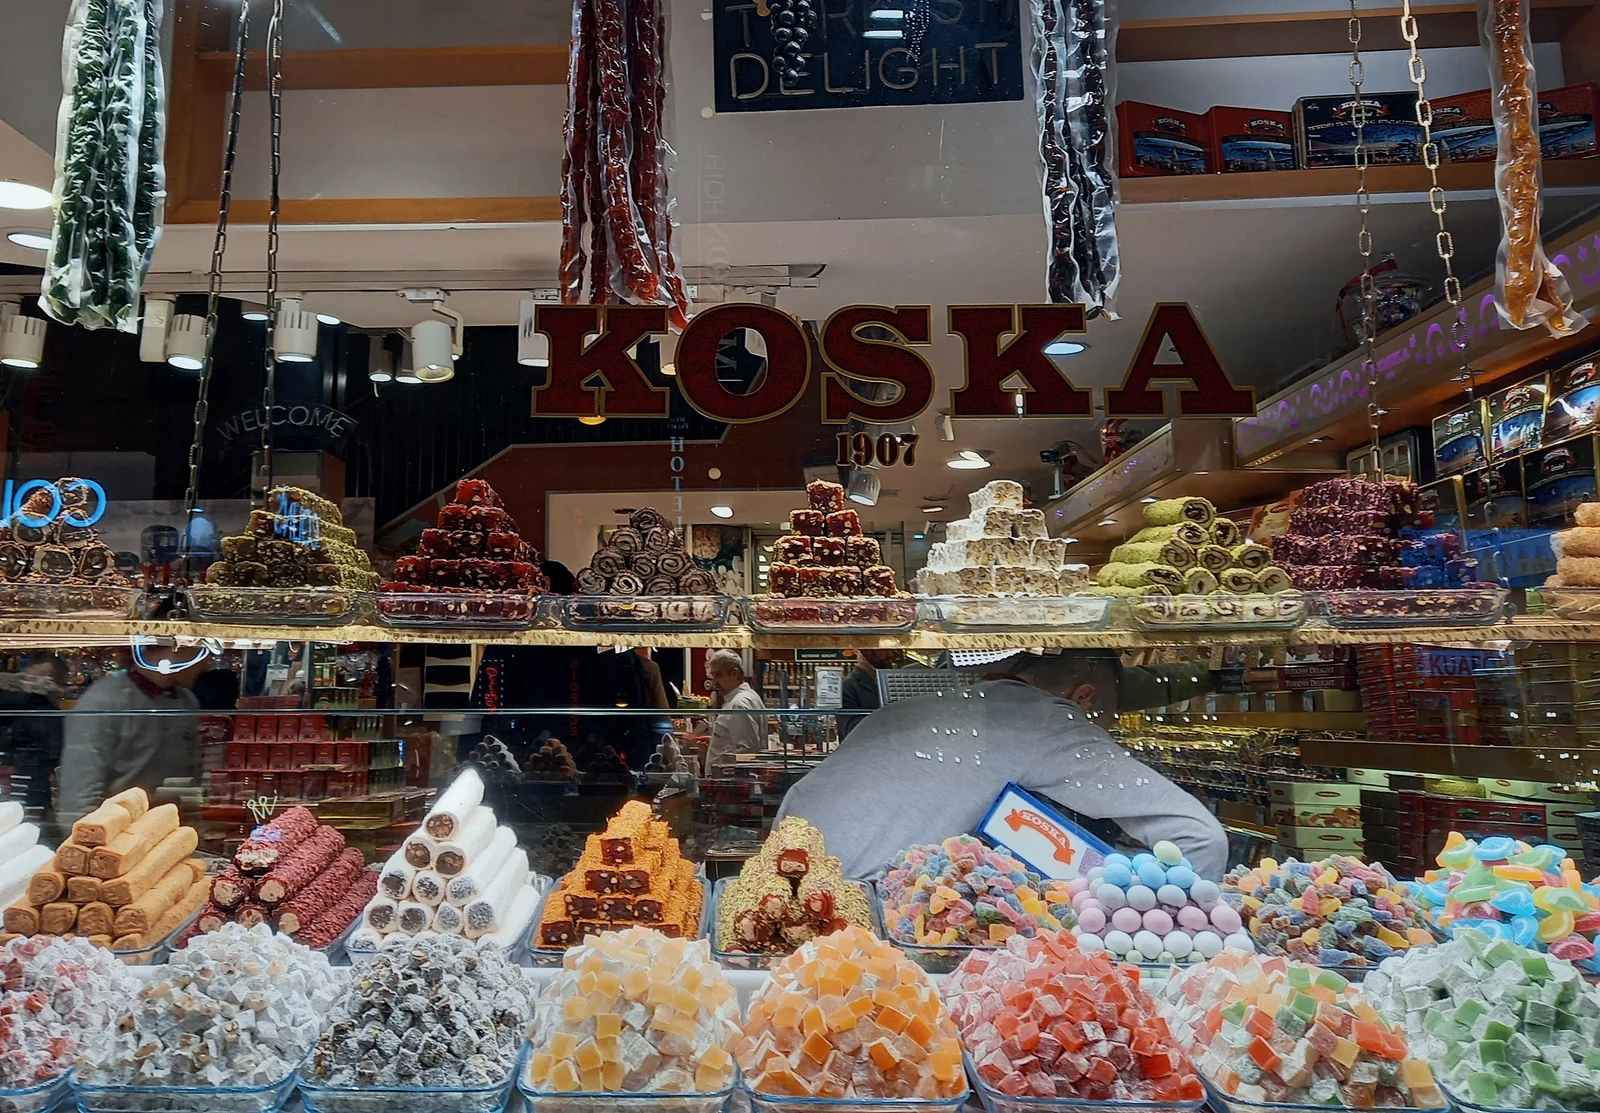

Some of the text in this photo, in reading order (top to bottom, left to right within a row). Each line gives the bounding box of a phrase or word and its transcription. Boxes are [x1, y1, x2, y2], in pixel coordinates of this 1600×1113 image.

[731, 42, 1009, 99] DELIGHT
[1157, 118, 1186, 129] KOSKA
[1250, 119, 1284, 128] KOSKA
[531, 302, 1257, 425] KOSKA
[215, 405, 354, 441] WELCOME
[836, 432, 920, 468] 1907
[1021, 811, 1067, 848] KOSKA
